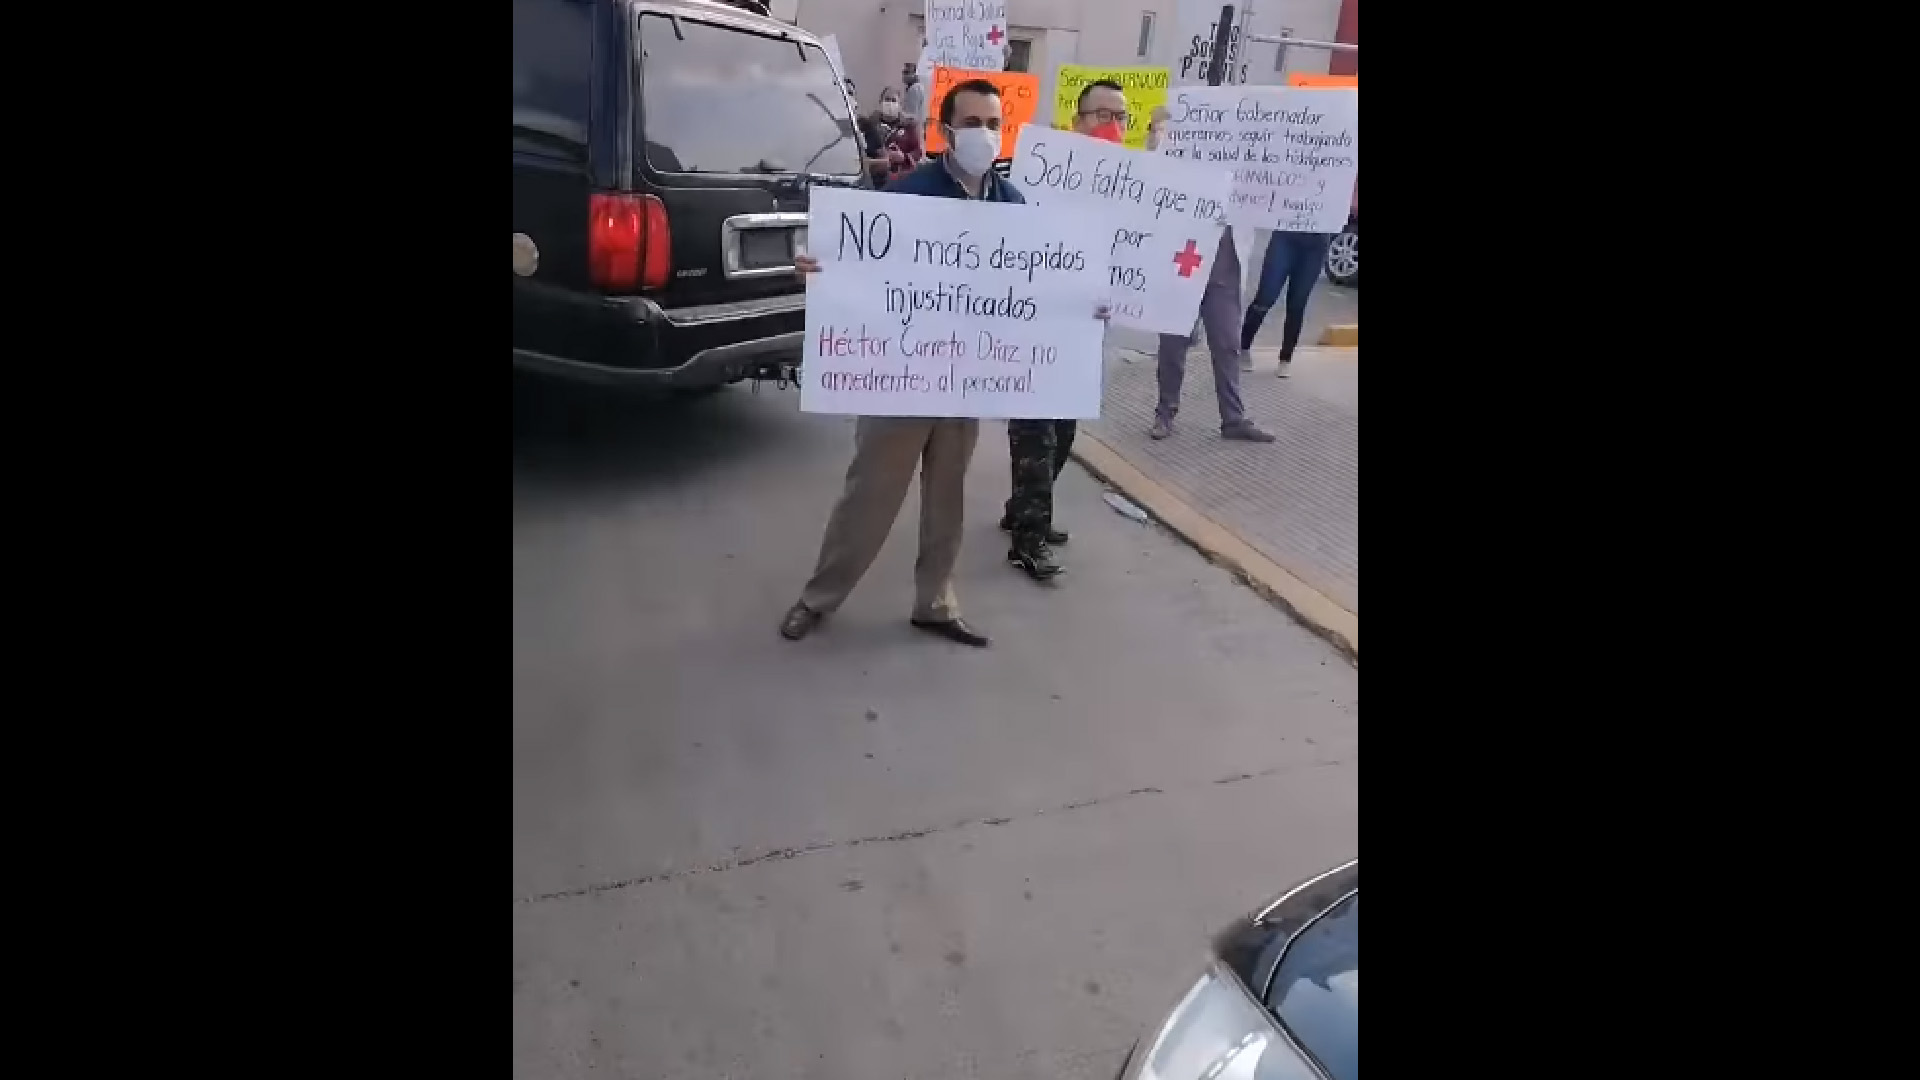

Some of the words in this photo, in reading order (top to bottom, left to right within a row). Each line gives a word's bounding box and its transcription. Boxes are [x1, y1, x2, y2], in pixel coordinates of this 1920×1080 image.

[1172, 94, 1229, 122] Señor
[1236, 97, 1325, 125] Gobernador
[1168, 129, 1233, 146] queremos
[1238, 128, 1274, 148] seguir
[1284, 128, 1352, 151] trabajando
[1192, 143, 1202, 159] la
[1208, 144, 1240, 162] salud
[1243, 147, 1258, 162] de
[1024, 142, 1083, 191] Solo
[1091, 158, 1145, 204] falta
[1152, 186, 1188, 219] que
[1193, 197, 1225, 221] nos
[837, 210, 893, 262] NO
[914, 230, 981, 271] más
[989, 236, 1086, 283] despidos
[1110, 228, 1153, 256] por
[885, 280, 1038, 325] injustificados
[819, 324, 892, 359] Héctor
[900, 324, 966, 358] Carreto
[976, 330, 1021, 363] Díaz
[1031, 343, 1058, 366] no
[821, 364, 931, 393] amedrentes
[938, 363, 955, 393] al
[962, 367, 1036, 399] personal.
